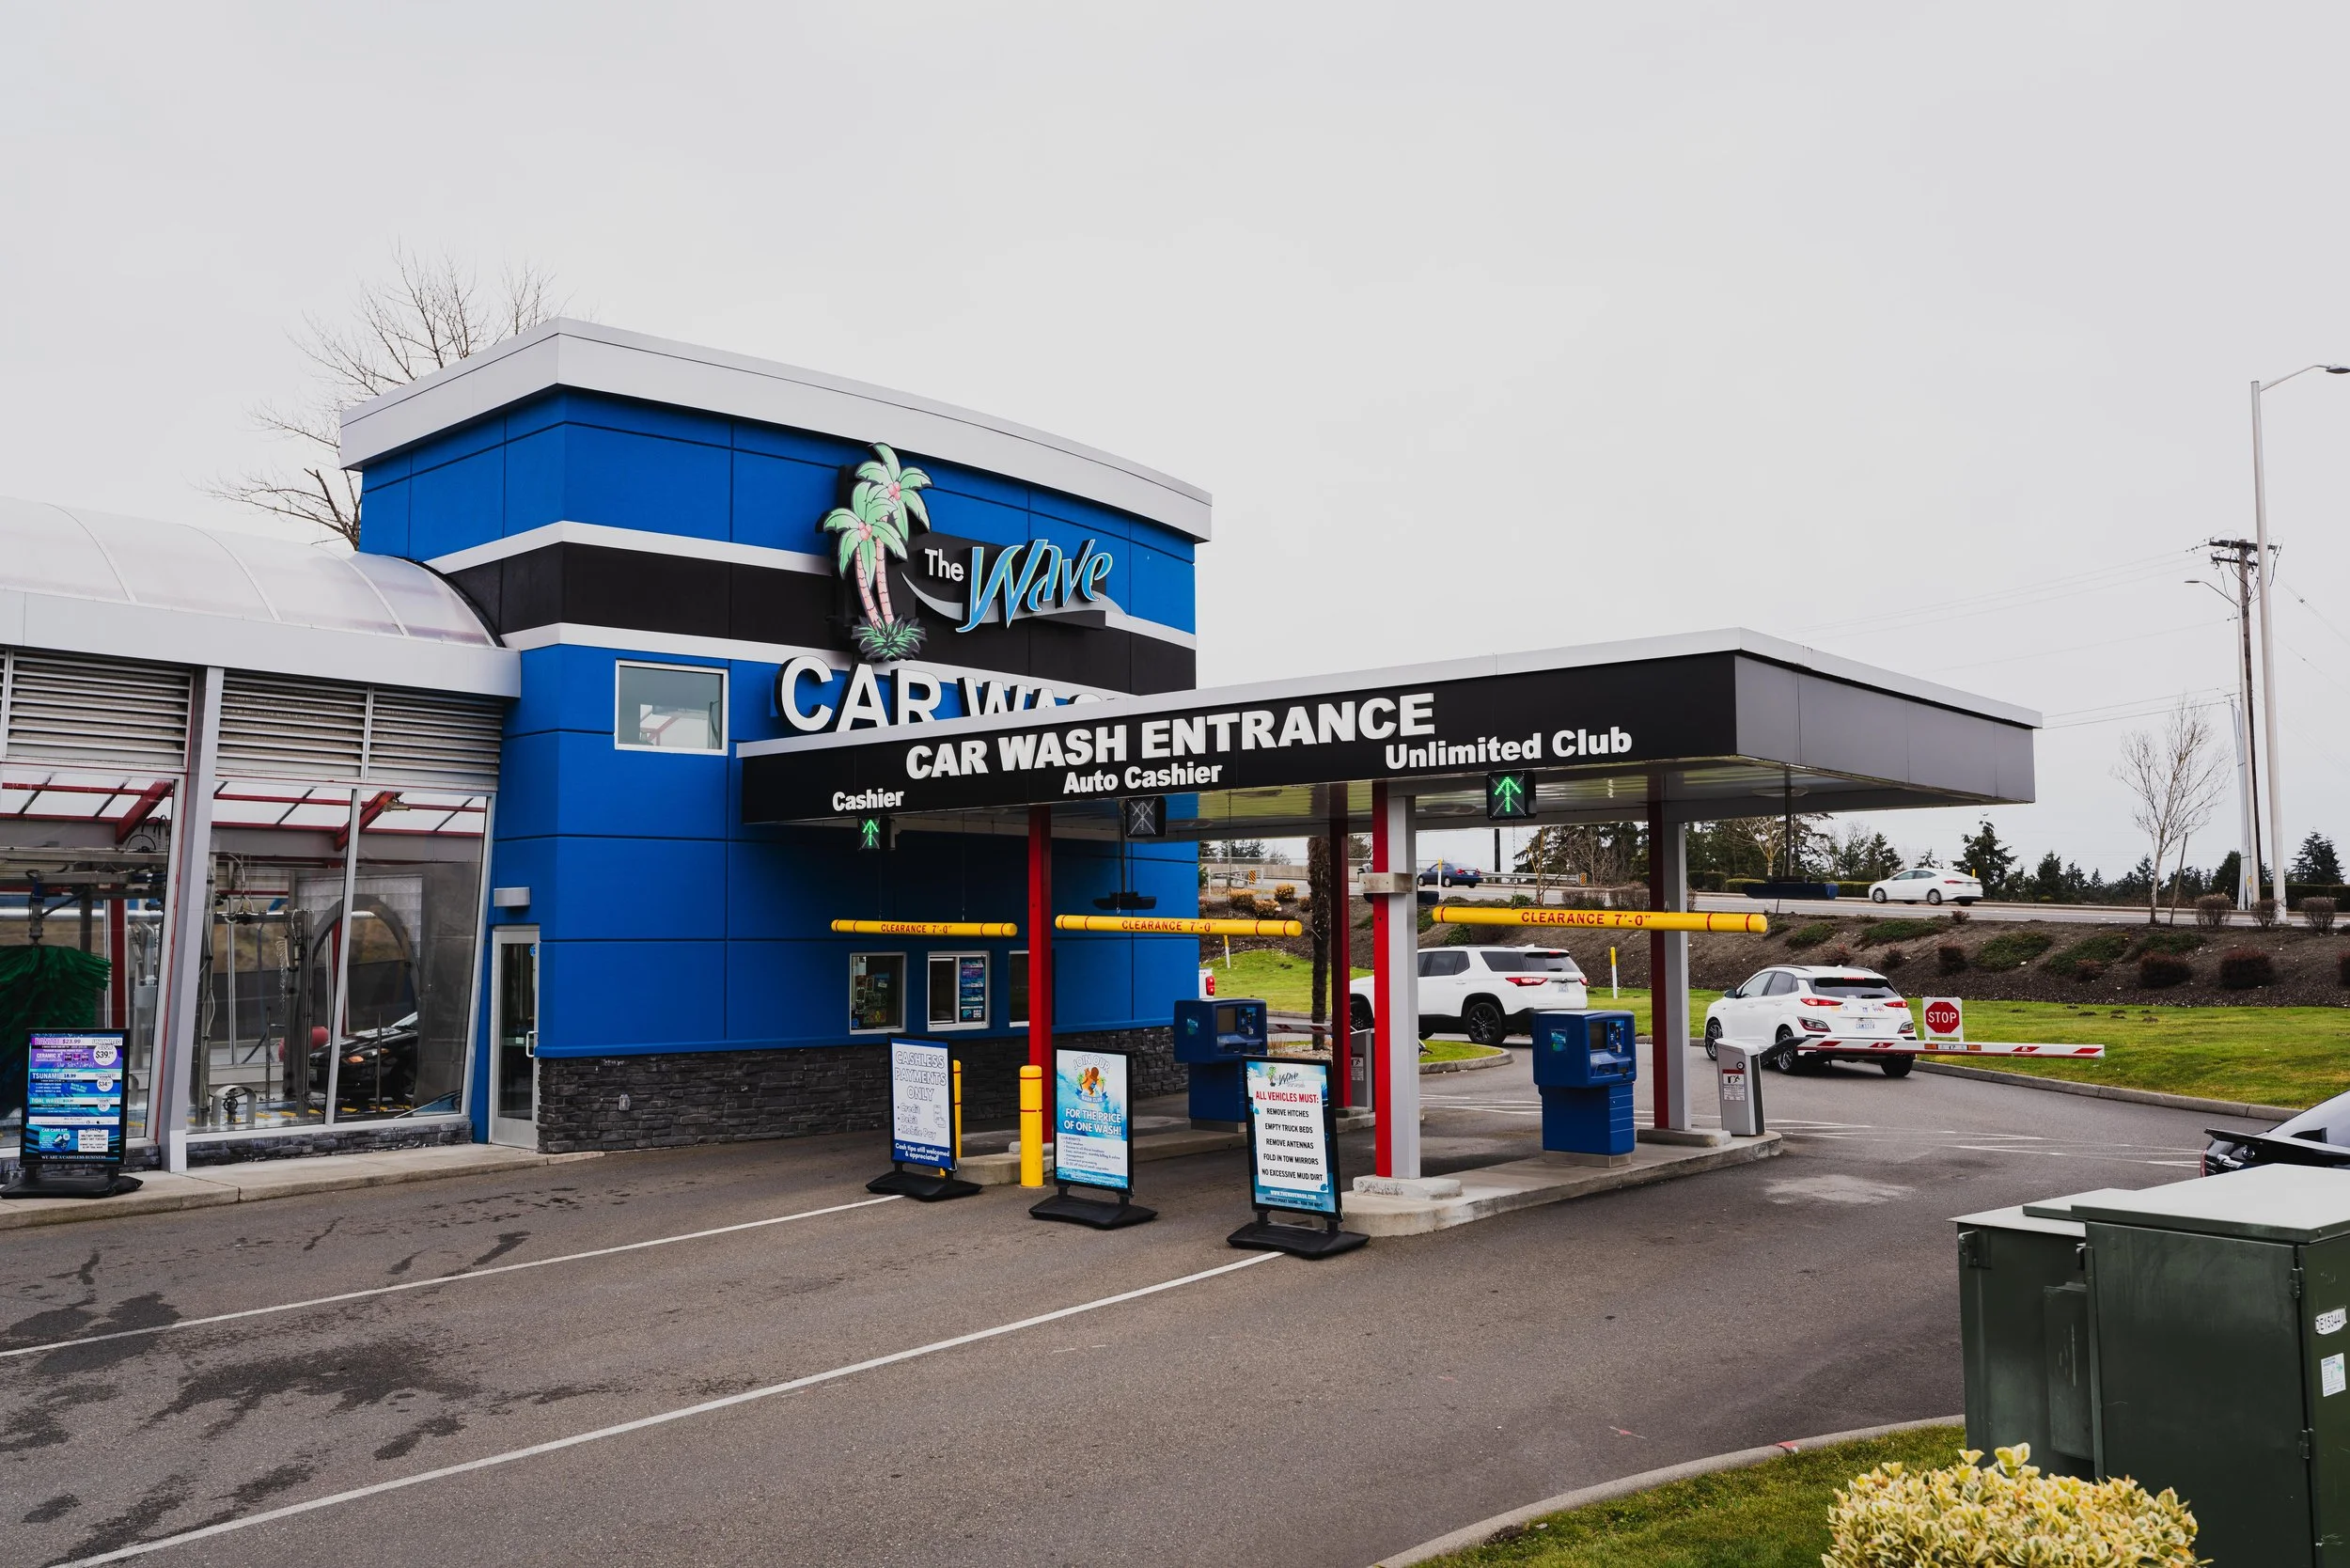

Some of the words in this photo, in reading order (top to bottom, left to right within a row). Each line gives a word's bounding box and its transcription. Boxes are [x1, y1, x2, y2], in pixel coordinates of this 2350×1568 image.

[924, 548, 964, 582] The
[955, 539, 1113, 633] Wave
[777, 656, 942, 731] CAR
[906, 742, 989, 780] CAR
[997, 724, 1127, 772] WASH
[1141, 693, 1435, 759] ENTRANCE
[1386, 733, 1542, 769] Unlimited
[1552, 727, 1633, 758] Club
[1063, 770, 1119, 794] Auto
[1123, 762, 1222, 789] Cashier
[833, 789, 904, 812] Cashier
[1121, 920, 1182, 931] CLEARANCE
[1521, 912, 1605, 925] CLEARANCE
[881, 924, 927, 933] CLEARANCE
[1928, 1011, 1956, 1024] STOP
[896, 1051, 945, 1069] CASHLESS
[1073, 1054, 1091, 1071] JOIN
[1092, 1056, 1110, 1074] OUR
[895, 1067, 947, 1086] PAYMENTS
[907, 1086, 934, 1102] ONLY
[1256, 1090, 1267, 1100] ALL
[1267, 1091, 1297, 1103] VEHICLES
[1299, 1093, 1319, 1104] MUST:
[1065, 1108, 1081, 1119] FOR
[1082, 1109, 1097, 1121] THE
[1098, 1112, 1121, 1123] PRICE
[1266, 1107, 1286, 1117] REMOVE
[1288, 1109, 1308, 1118] HITCHES
[1064, 1121, 1075, 1130] OF
[1075, 1121, 1092, 1133] ONE
[1094, 1123, 1121, 1136] WASH!
[1265, 1122, 1281, 1131] EMPTY
[1282, 1124, 1298, 1133] TRUCK
[1266, 1138, 1286, 1147] REMOVE
[1287, 1140, 1314, 1149] ANTENNAS
[926, 1148, 949, 1157] welcomed
[1295, 1156, 1319, 1166] MIRRORS
[1270, 1169, 1296, 1179] EXCESSIVE
